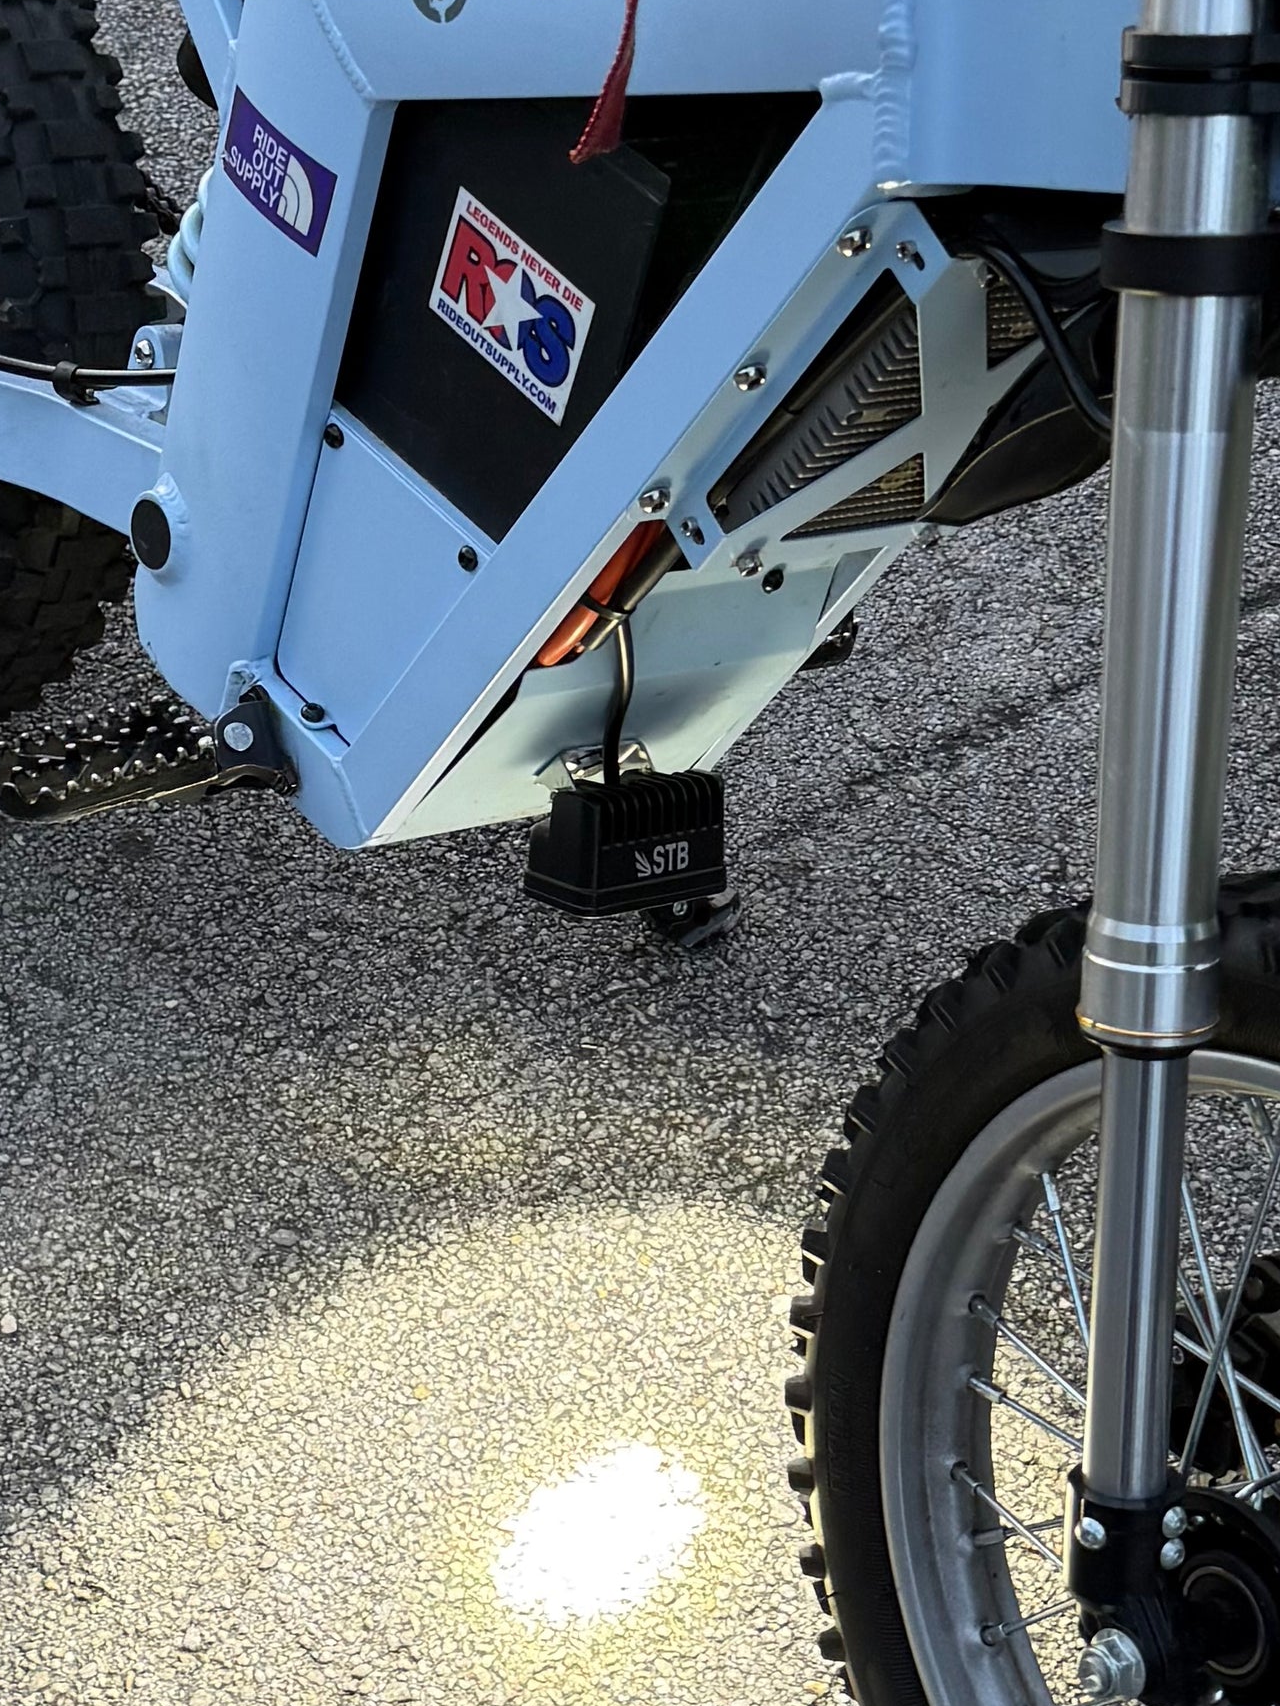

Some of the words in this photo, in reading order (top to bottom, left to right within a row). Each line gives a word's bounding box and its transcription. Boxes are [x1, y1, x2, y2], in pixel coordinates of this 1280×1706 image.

[252, 124, 287, 170] RIDE
[252, 150, 285, 188] OUT
[228, 145, 280, 208] SUPPLY
[465, 200, 519, 255] LEGENDS
[520, 249, 560, 293] NEVER
[562, 285, 583, 313] DIE
[437, 297, 557, 414] RIDEOUTSUPPLY.COM
[653, 840, 689, 875] STB
